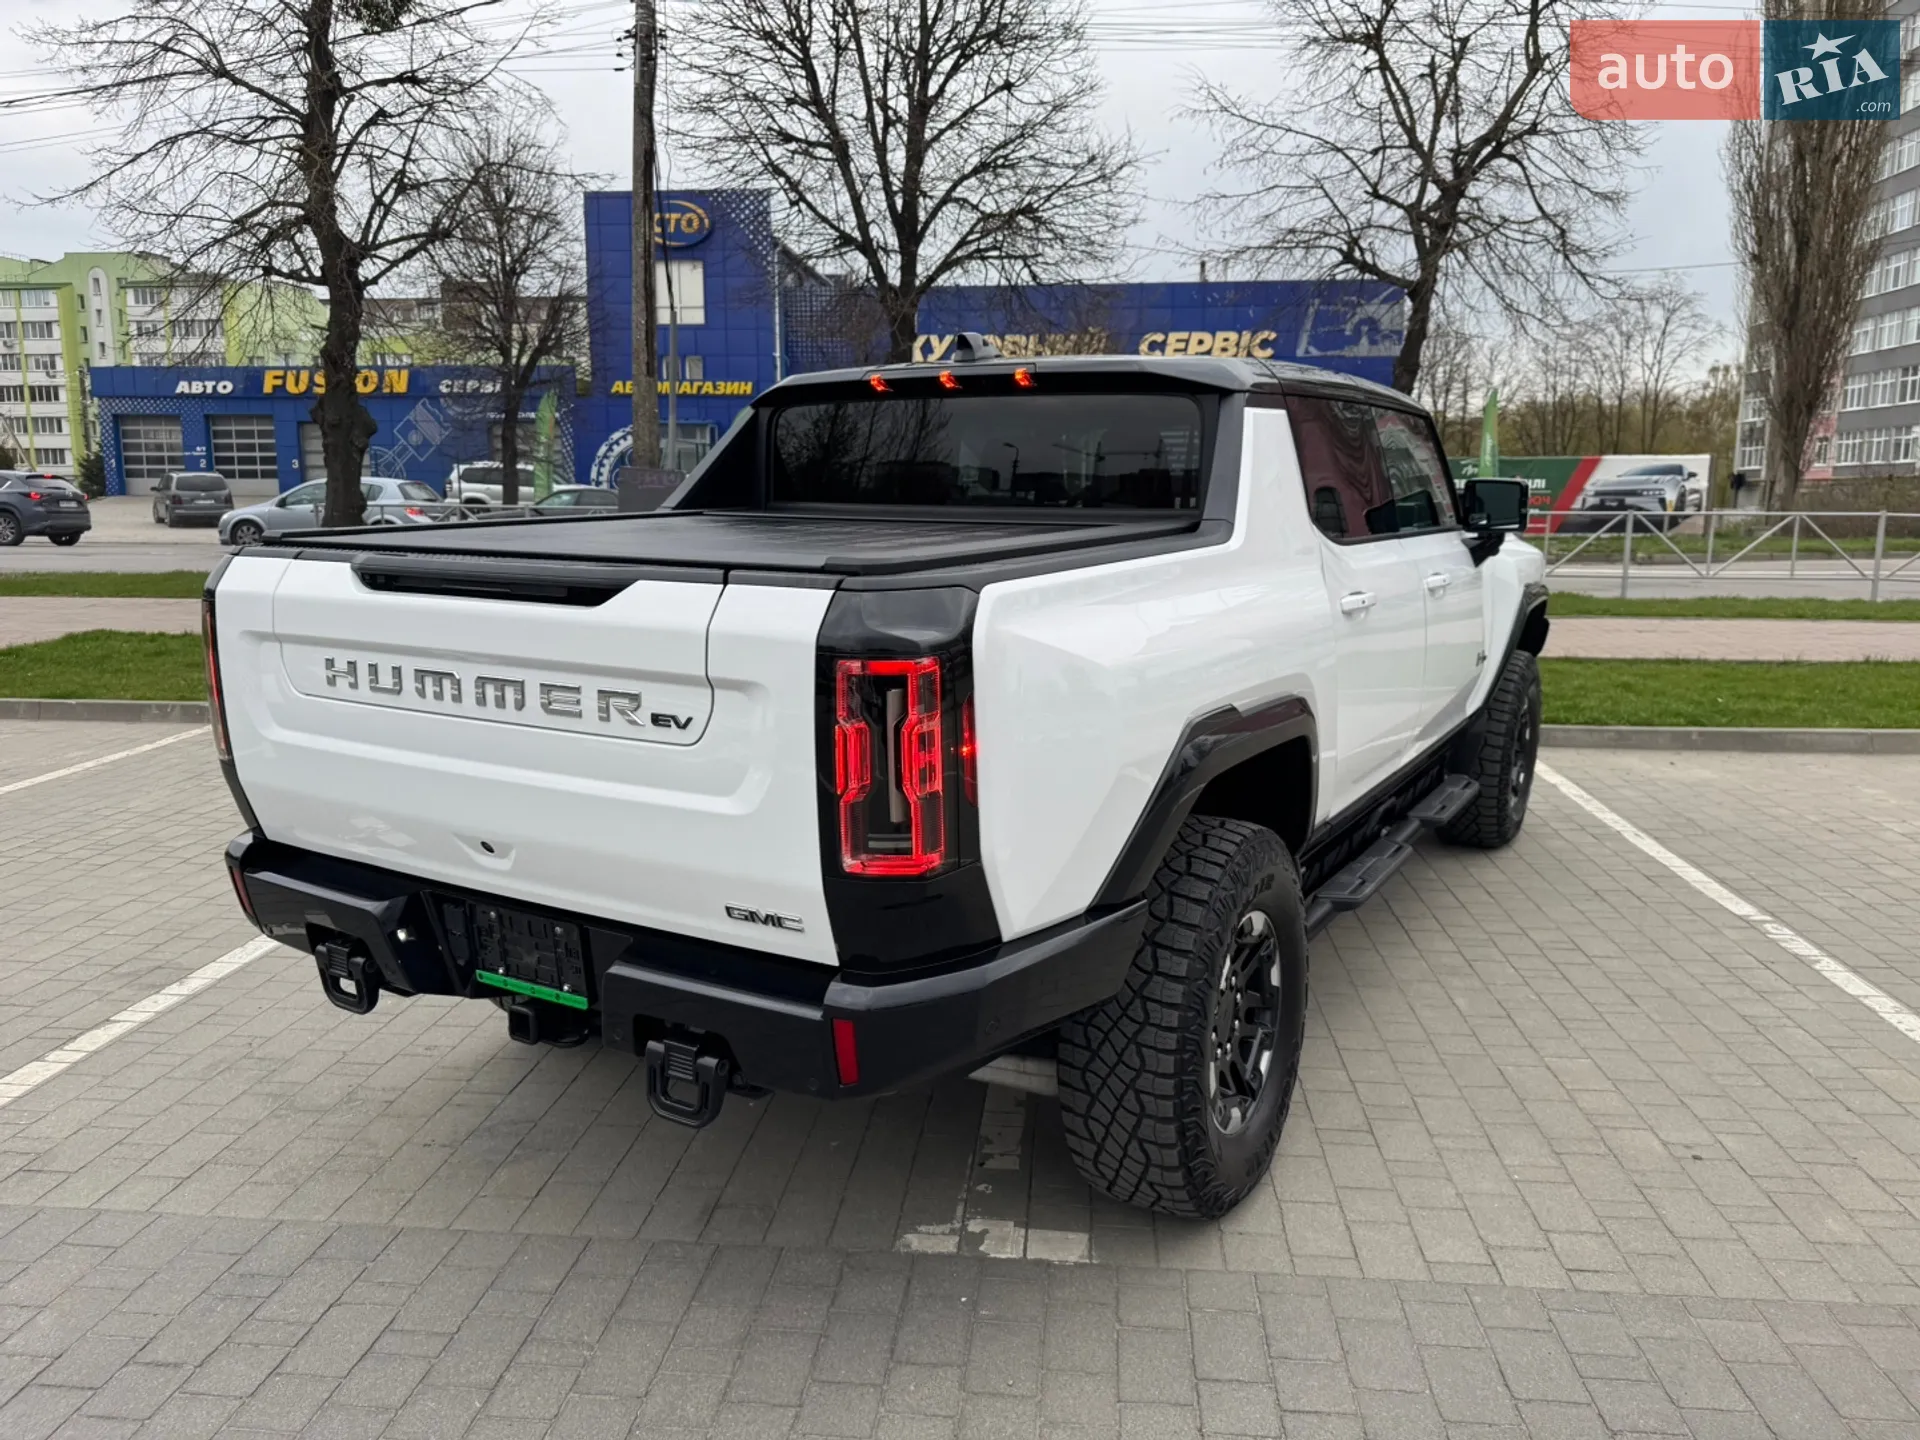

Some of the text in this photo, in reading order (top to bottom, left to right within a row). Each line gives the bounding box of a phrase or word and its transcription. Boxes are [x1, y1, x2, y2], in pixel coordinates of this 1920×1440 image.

[653, 212, 700, 234] СТО
[1138, 329, 1278, 359] СЕРВІС
[175, 380, 235, 395] АВТО
[262, 368, 410, 395] FUSON
[438, 378, 517, 394] СЕРВІ
[200, 458, 207, 468] 2
[291, 458, 300, 469] 3
[324, 656, 694, 730] HUMMER EV
[724, 902, 806, 933] GMC
